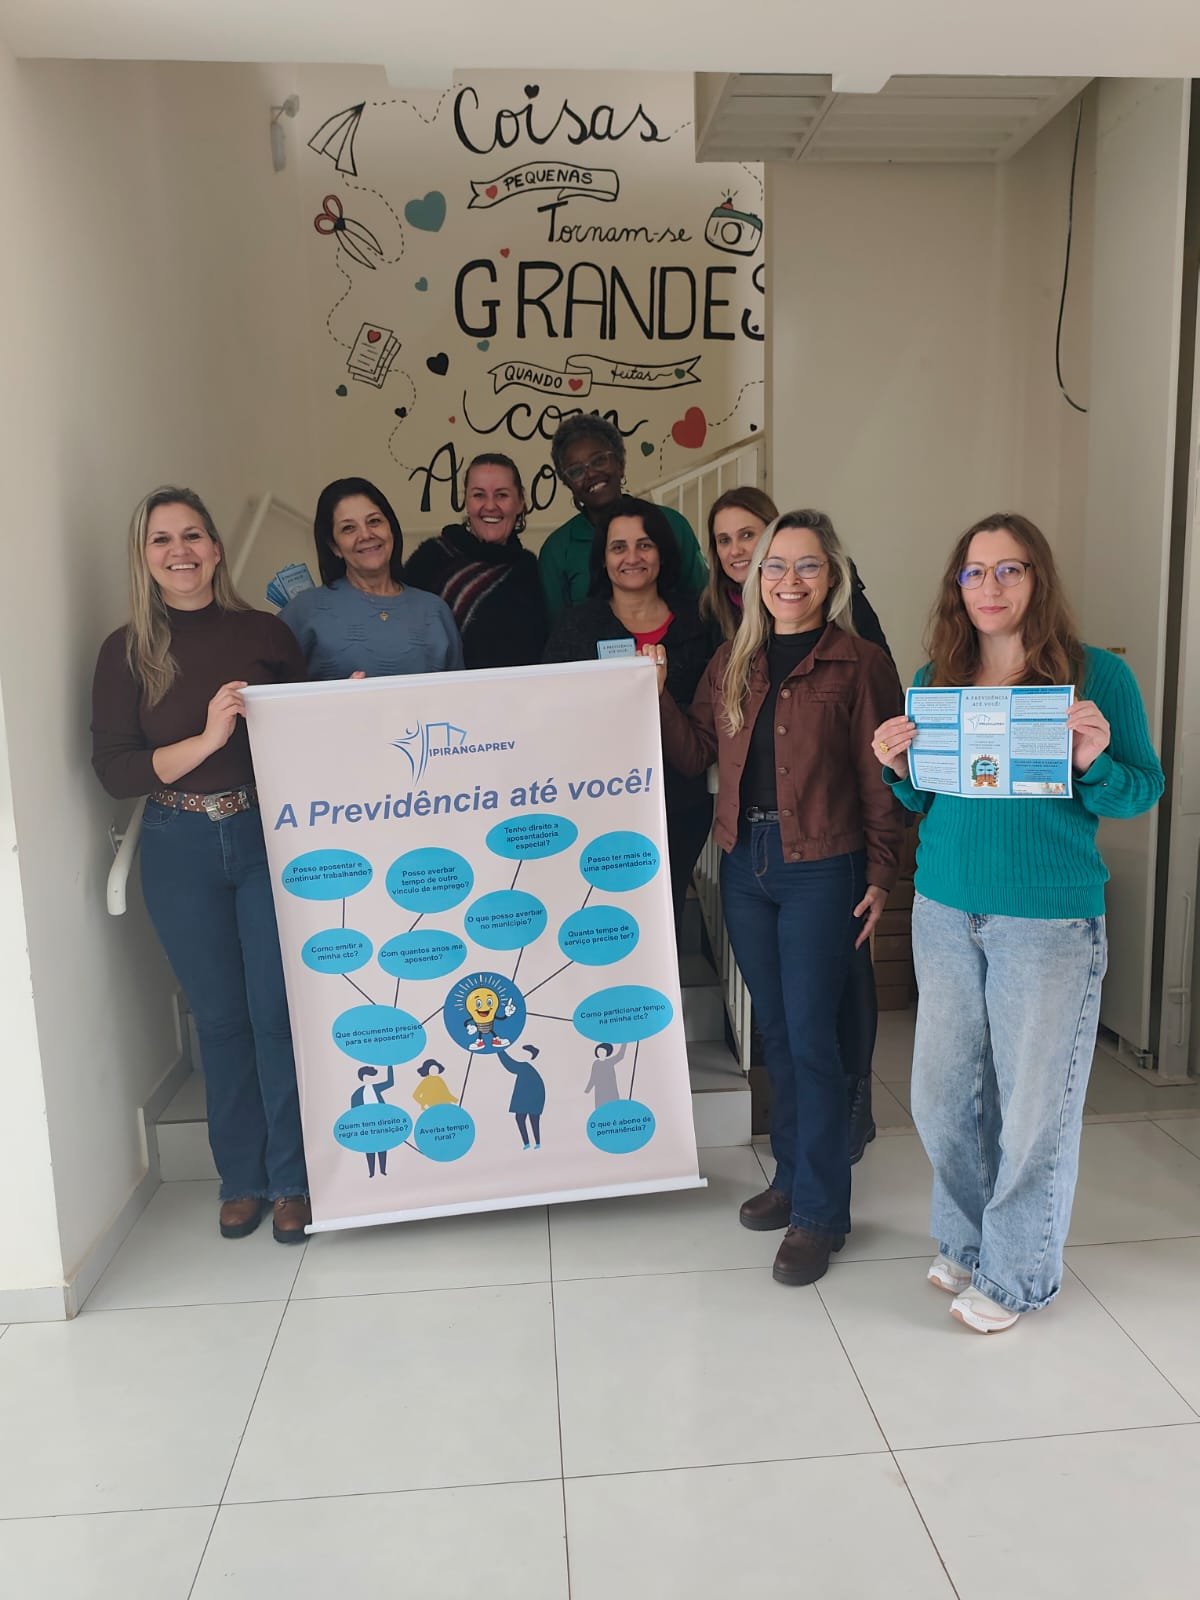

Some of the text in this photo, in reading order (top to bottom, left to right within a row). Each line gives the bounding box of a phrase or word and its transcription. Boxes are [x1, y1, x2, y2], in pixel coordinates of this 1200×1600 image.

[453, 85, 671, 154] Coisas
[504, 168, 593, 191] PEQUENAS
[537, 200, 693, 243] Tornam-se
[504, 365, 563, 389] QUANDO
[429, 741, 515, 757] IPIRANGAPREV
[274, 767, 653, 830] A Previdência até você!
[504, 826, 527, 834] Tenho
[528, 823, 553, 832] direito
[506, 831, 559, 842] aposentadoria
[515, 840, 550, 850] especial?
[587, 855, 611, 863] Posso
[612, 853, 622, 861] ter
[623, 852, 641, 860] mais
[292, 866, 317, 874] Posso
[318, 862, 356, 872] aposentar
[402, 866, 456, 878] Posso averbar
[583, 859, 657, 873] uma aposentadoria?
[285, 868, 373, 884] continuar trabalhando?
[401, 878, 426, 886] tempo
[421, 885, 431, 893] de
[432, 881, 470, 891] emprego?
[475, 915, 490, 923] que
[491, 912, 514, 921] posso
[515, 909, 544, 918] averbar
[567, 928, 595, 938] Quanto
[595, 926, 618, 935] tempo
[564, 932, 634, 947] serviço preciso ter?
[311, 945, 334, 954] Como
[335, 943, 356, 951] emitir
[381, 949, 399, 958] Com
[400, 947, 430, 957] quantos
[318, 952, 341, 961] minha
[404, 954, 443, 965] aposento?
[580, 1011, 602, 1019] Como
[643, 1003, 666, 1012] tempo
[609, 1014, 632, 1024] minha
[335, 1024, 423, 1039] Que documento preciso
[345, 1038, 362, 1047] para
[373, 1032, 415, 1044] aposentar?
[338, 1122, 361, 1130] Quem
[361, 1120, 376, 1128] tem
[377, 1117, 401, 1126] direito
[597, 1120, 611, 1128] que
[618, 1117, 641, 1126] abono
[338, 1131, 358, 1139] regra
[370, 1124, 409, 1135] transição?
[419, 1124, 470, 1135] Averba tempo
[596, 1124, 646, 1136] permanência?
[434, 1132, 456, 1141] rural?
